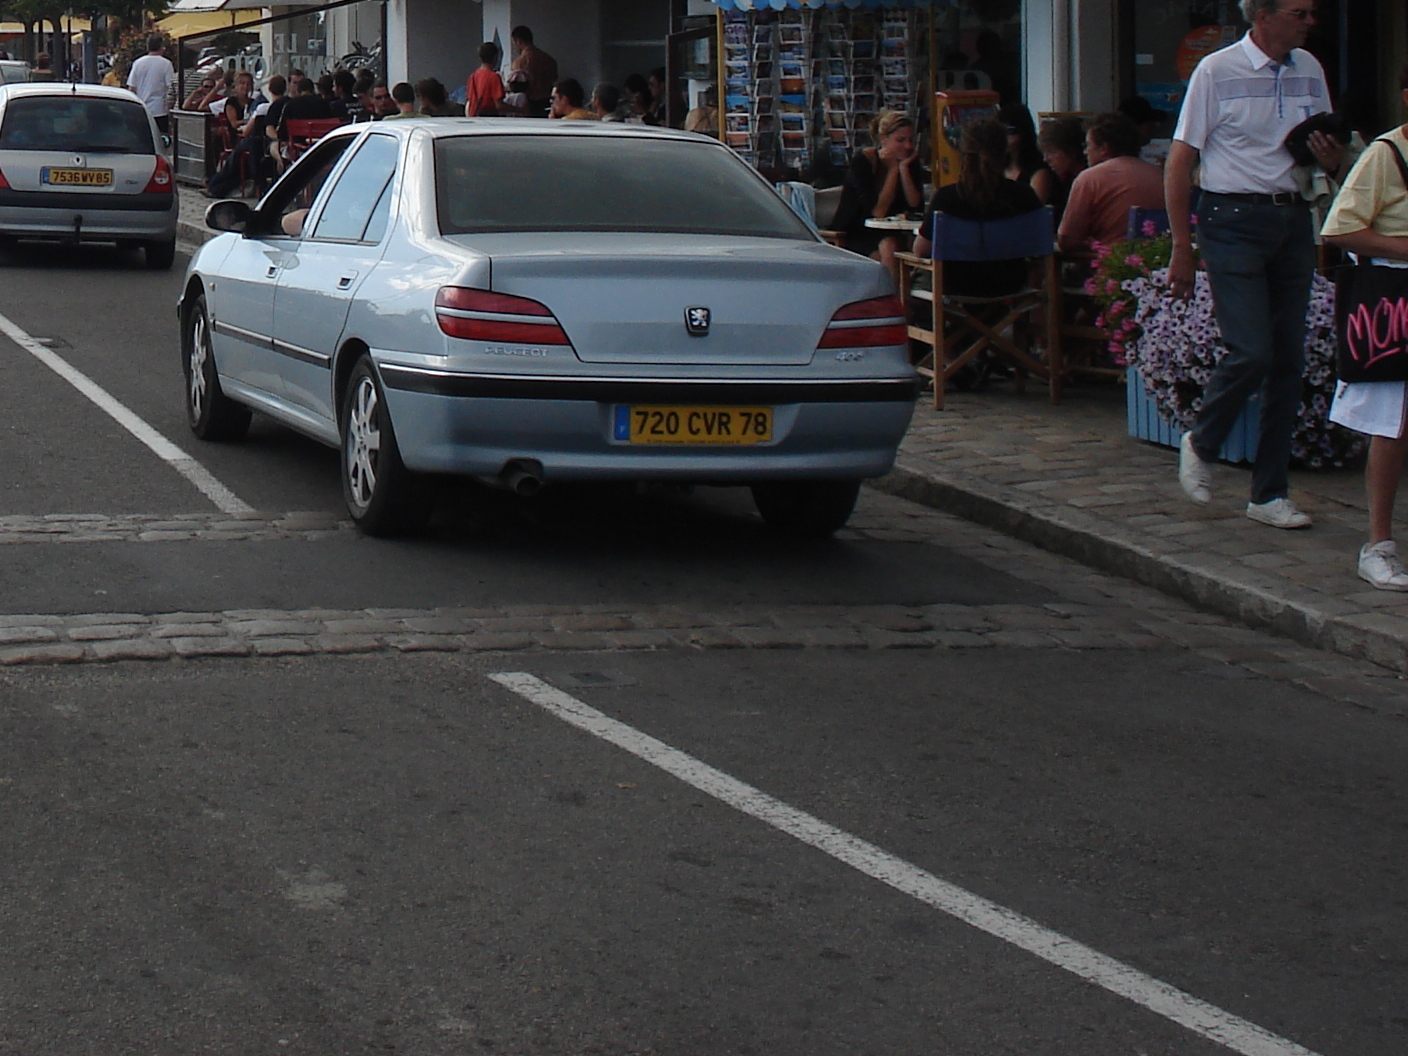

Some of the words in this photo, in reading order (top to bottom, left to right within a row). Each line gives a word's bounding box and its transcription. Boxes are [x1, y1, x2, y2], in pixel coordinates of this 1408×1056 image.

[635, 410, 680, 436] 720
[687, 411, 731, 436] CVR
[739, 412, 768, 436] 78
